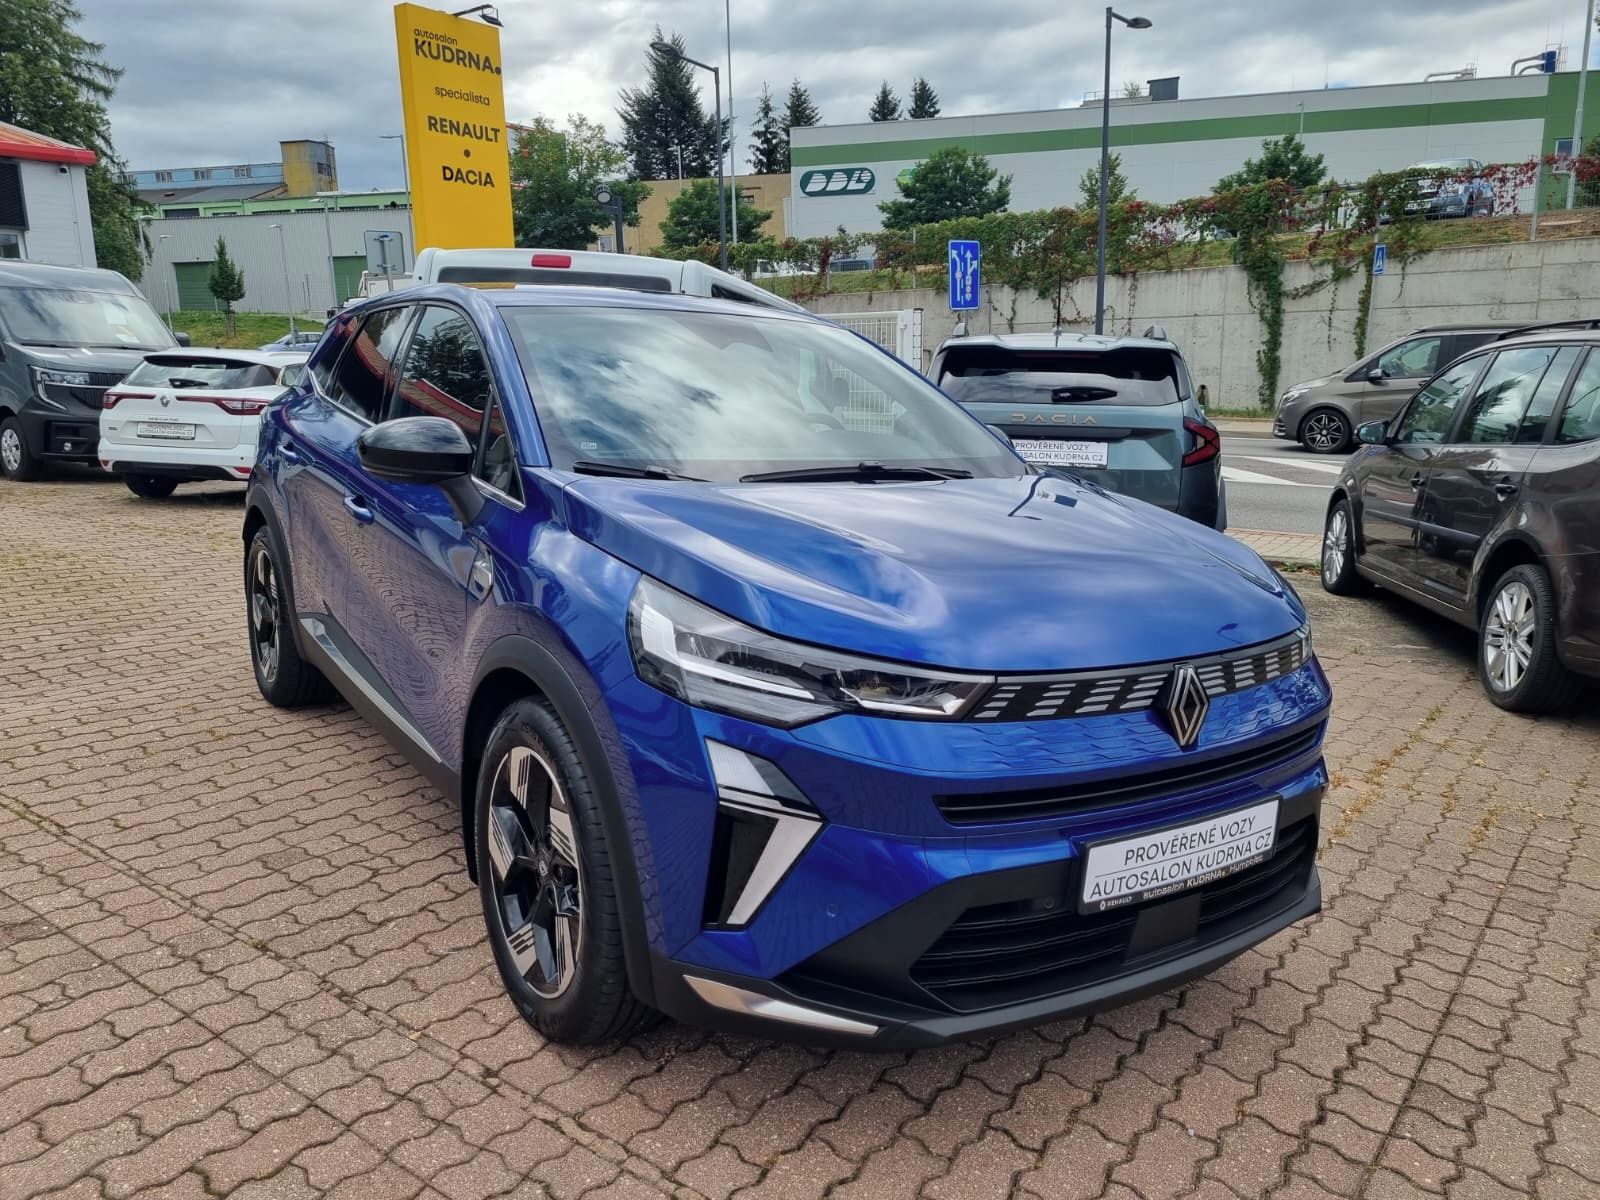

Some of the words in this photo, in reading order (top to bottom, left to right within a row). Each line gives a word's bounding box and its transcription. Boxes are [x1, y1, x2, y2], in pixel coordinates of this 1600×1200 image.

[413, 27, 458, 46] autosalon
[434, 86, 491, 106] specialista
[427, 115, 500, 143] RENAULT
[442, 165, 495, 188] DACIA
[1011, 413, 1097, 425] DACIA
[1066, 443, 1089, 451] VOZY
[1054, 453, 1090, 462] KUDRNA
[1124, 824, 1217, 866] PROVĚŘENÉ
[1220, 815, 1256, 839] VOZY
[1090, 858, 1193, 899] AUTOSALON
[1196, 840, 1252, 872] KUDRNA
[1255, 832, 1272, 850] CZ
